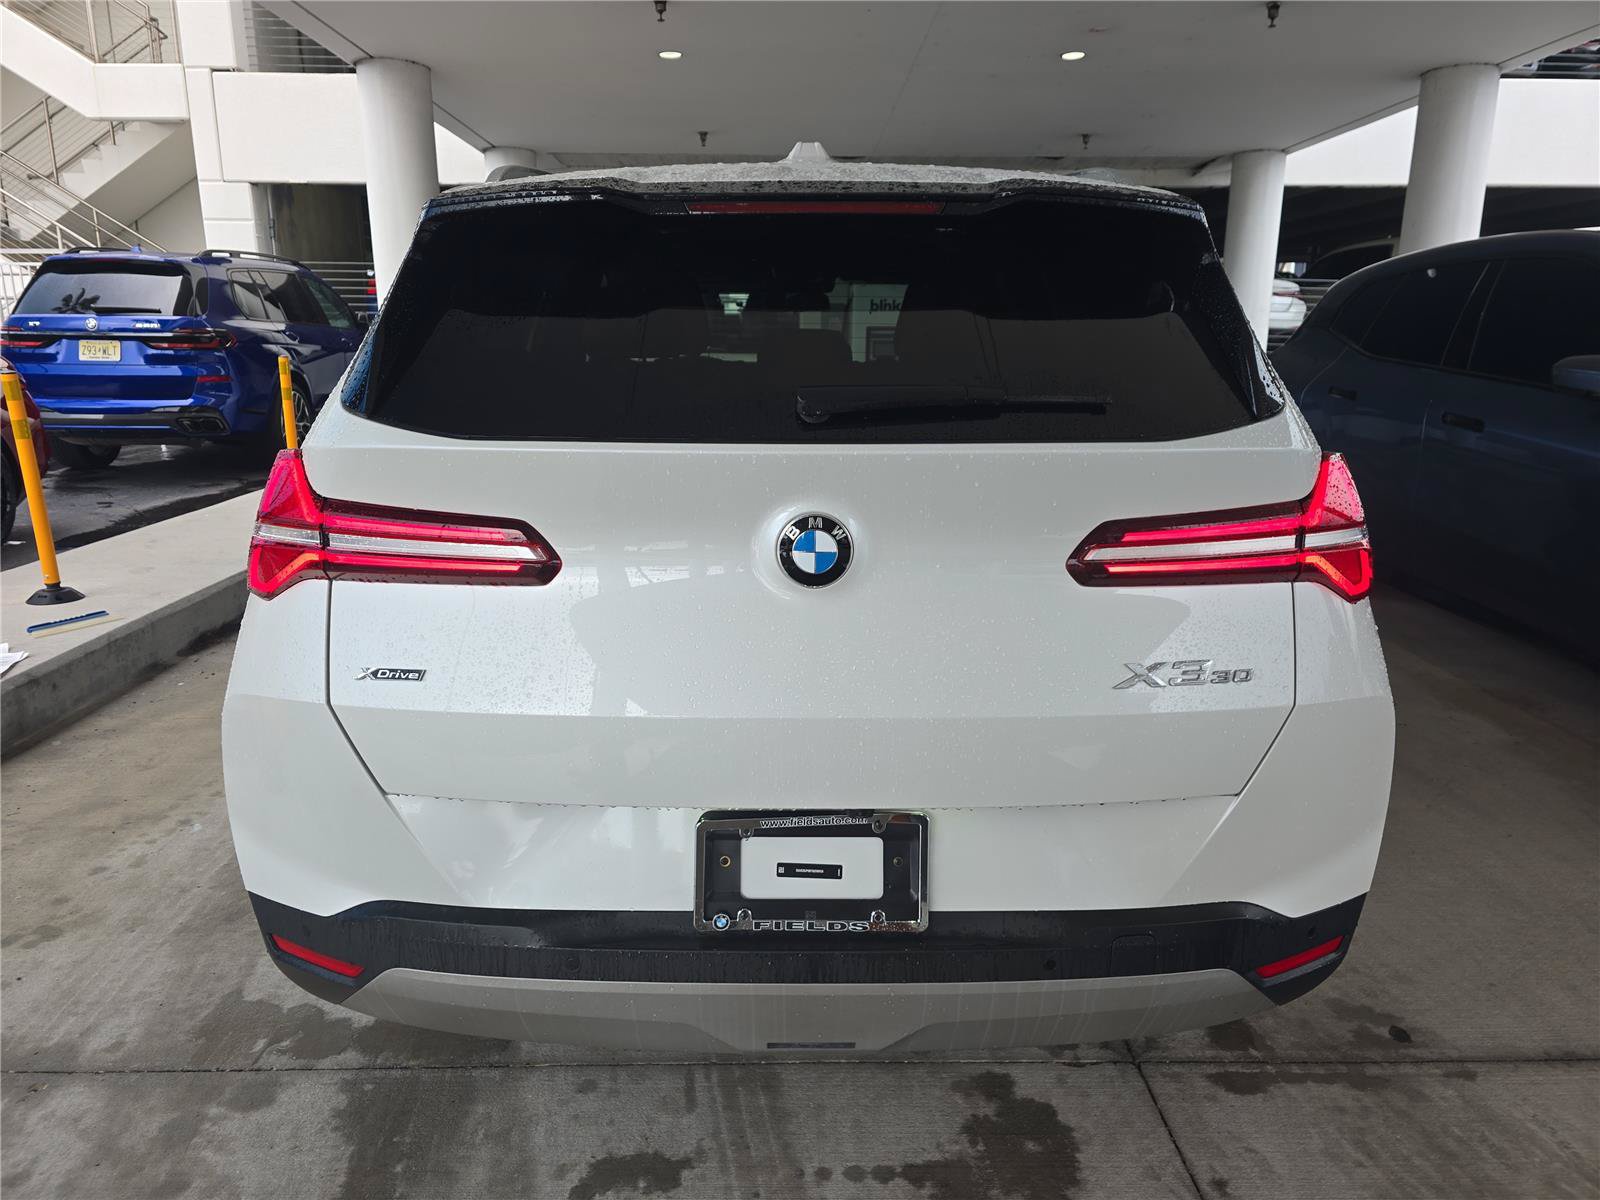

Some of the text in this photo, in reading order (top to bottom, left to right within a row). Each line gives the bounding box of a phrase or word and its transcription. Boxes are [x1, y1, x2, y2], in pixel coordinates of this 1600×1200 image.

[785, 516, 847, 541] BMW
[760, 815, 868, 829] www.fieldsauto.com
[752, 920, 871, 932] FIELDS
